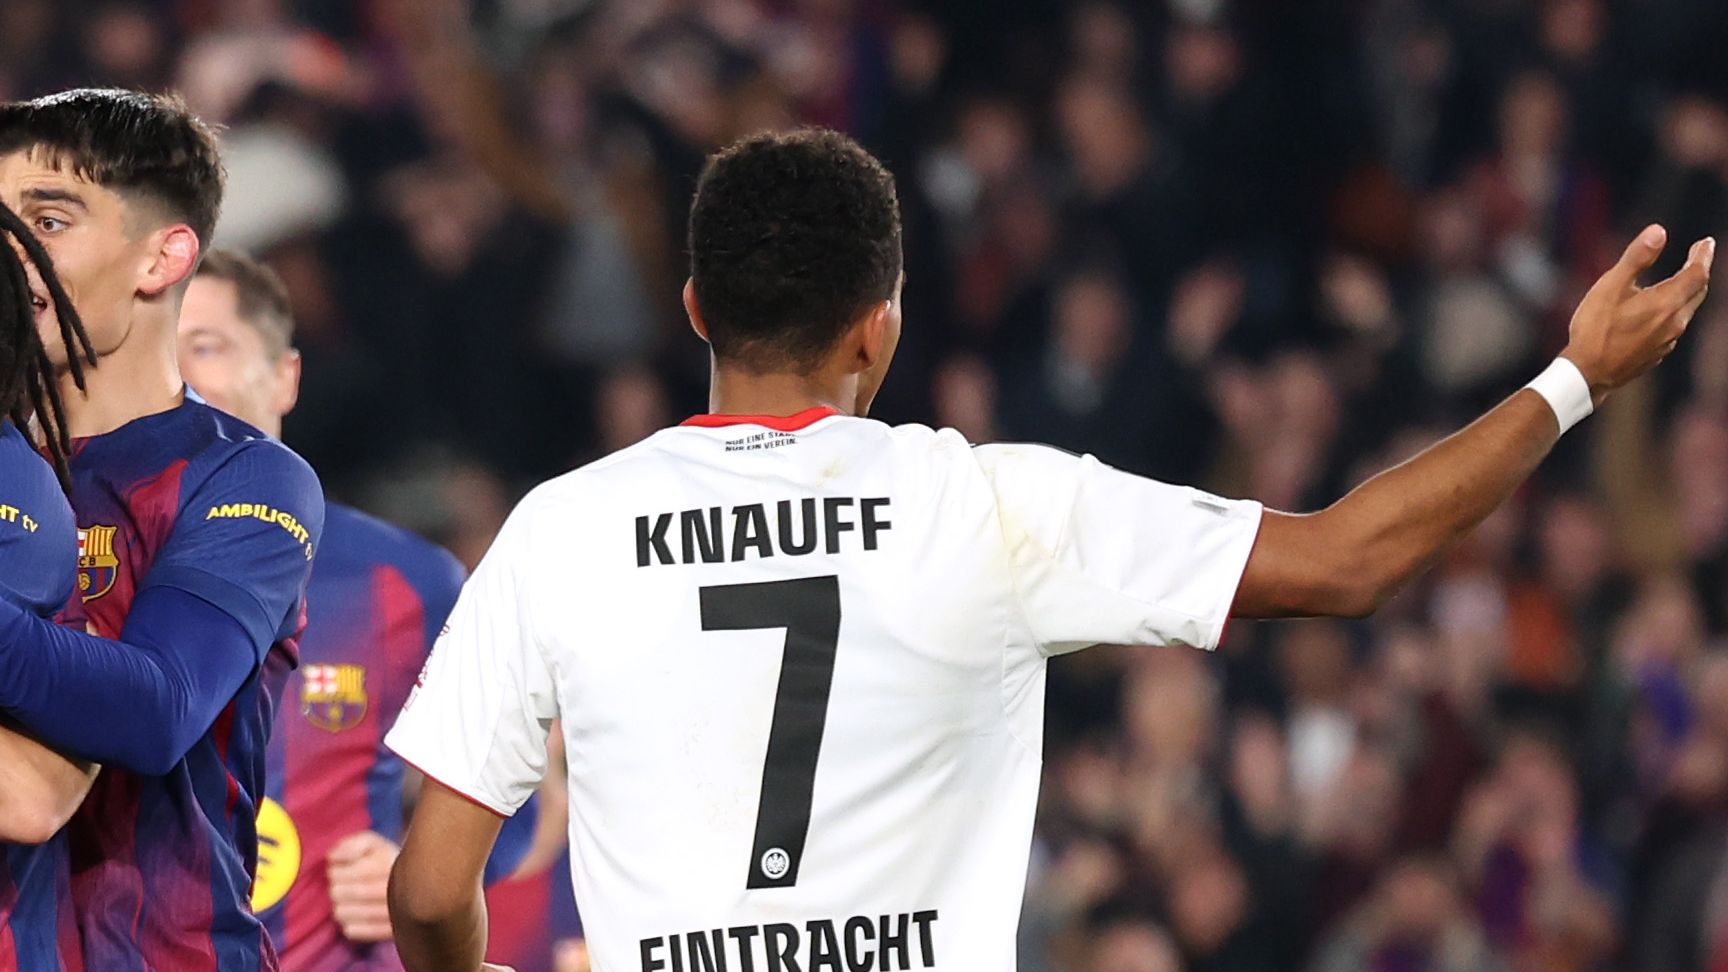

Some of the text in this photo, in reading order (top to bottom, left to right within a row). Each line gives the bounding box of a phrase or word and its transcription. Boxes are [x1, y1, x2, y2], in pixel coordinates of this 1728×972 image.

[206, 503, 309, 545] AMBILIGHT
[635, 497, 891, 567] KNAUFF
[699, 574, 841, 889] 7
